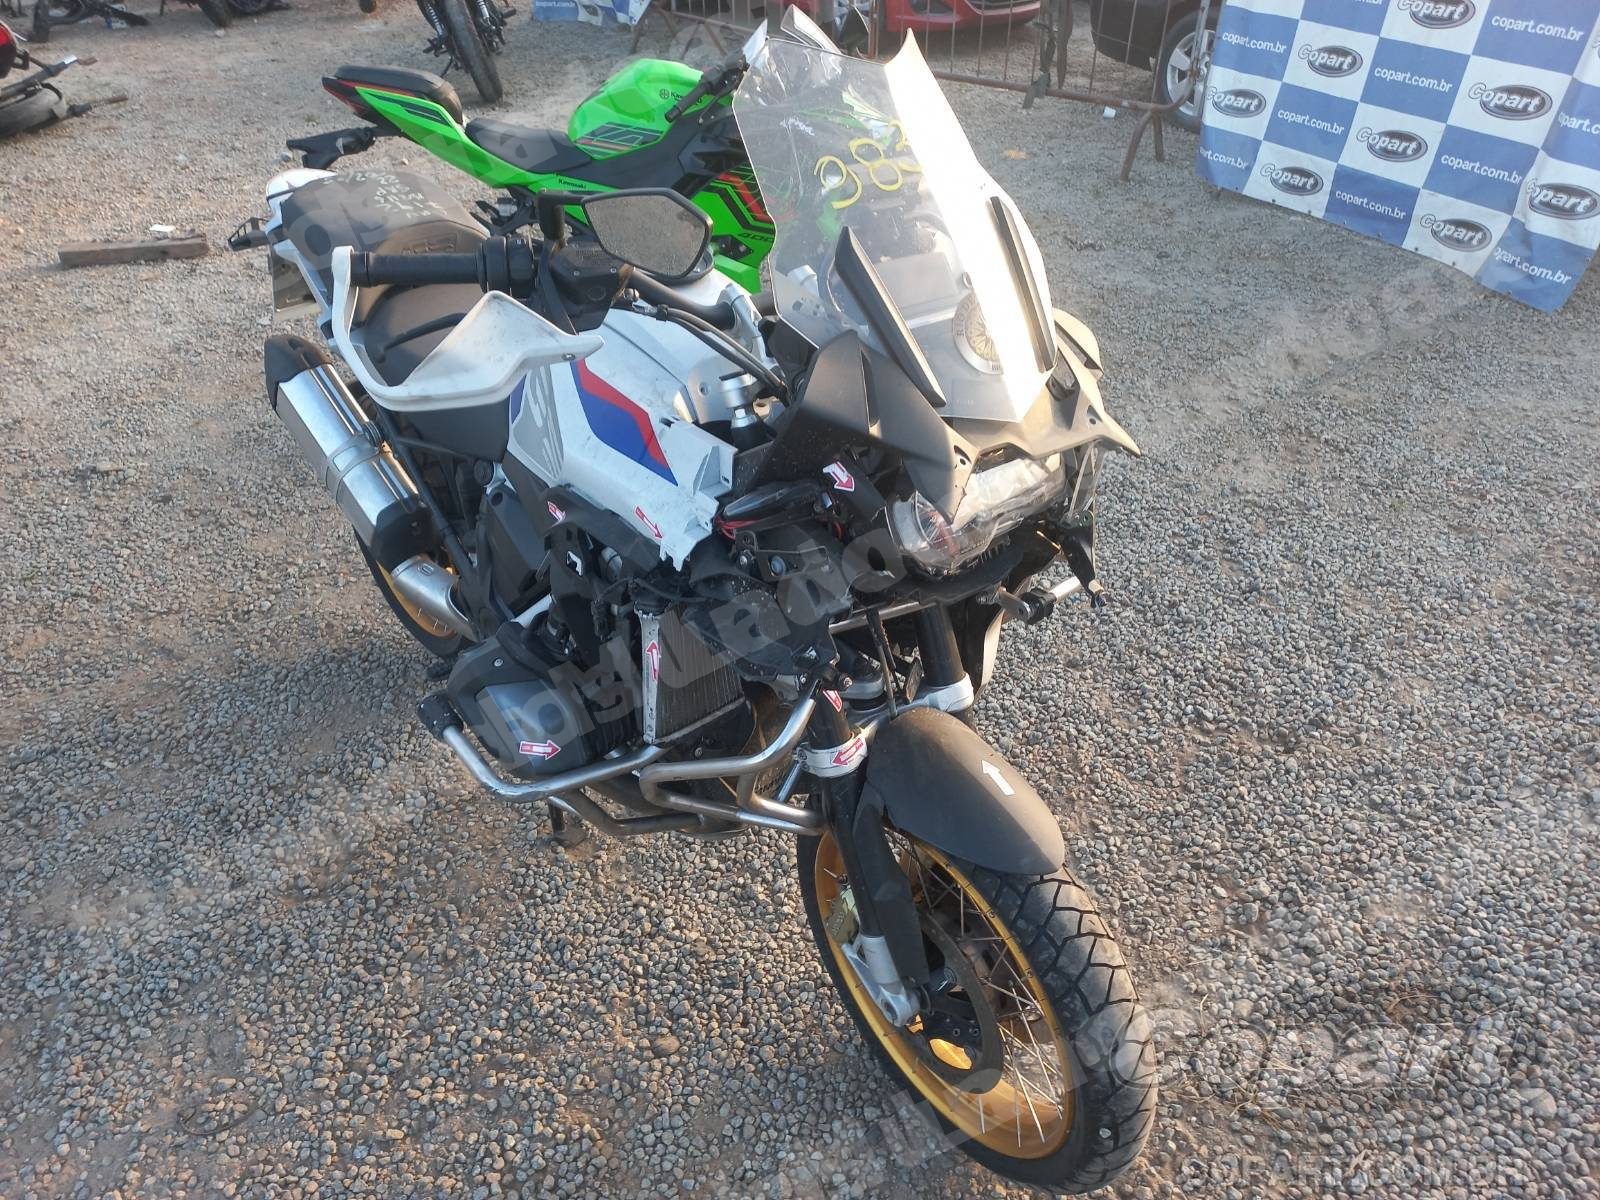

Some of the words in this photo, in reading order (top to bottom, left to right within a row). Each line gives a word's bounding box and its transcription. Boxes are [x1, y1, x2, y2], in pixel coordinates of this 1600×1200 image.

[1397, 0, 1464, 19] Copart
[1491, 15, 1584, 41] copart.com.br
[1221, 31, 1287, 54] copart.com.br
[1298, 44, 1353, 69] Copart
[1374, 66, 1453, 93] copart.com.br
[1468, 82, 1542, 112] Copart
[1277, 109, 1345, 135] copart.com.br
[1356, 126, 1418, 155] Copart
[1260, 162, 1315, 189] Copart
[1441, 154, 1522, 185] copart.com.br
[1335, 189, 1406, 220] copart.com.br
[1420, 213, 1483, 245] Copart
